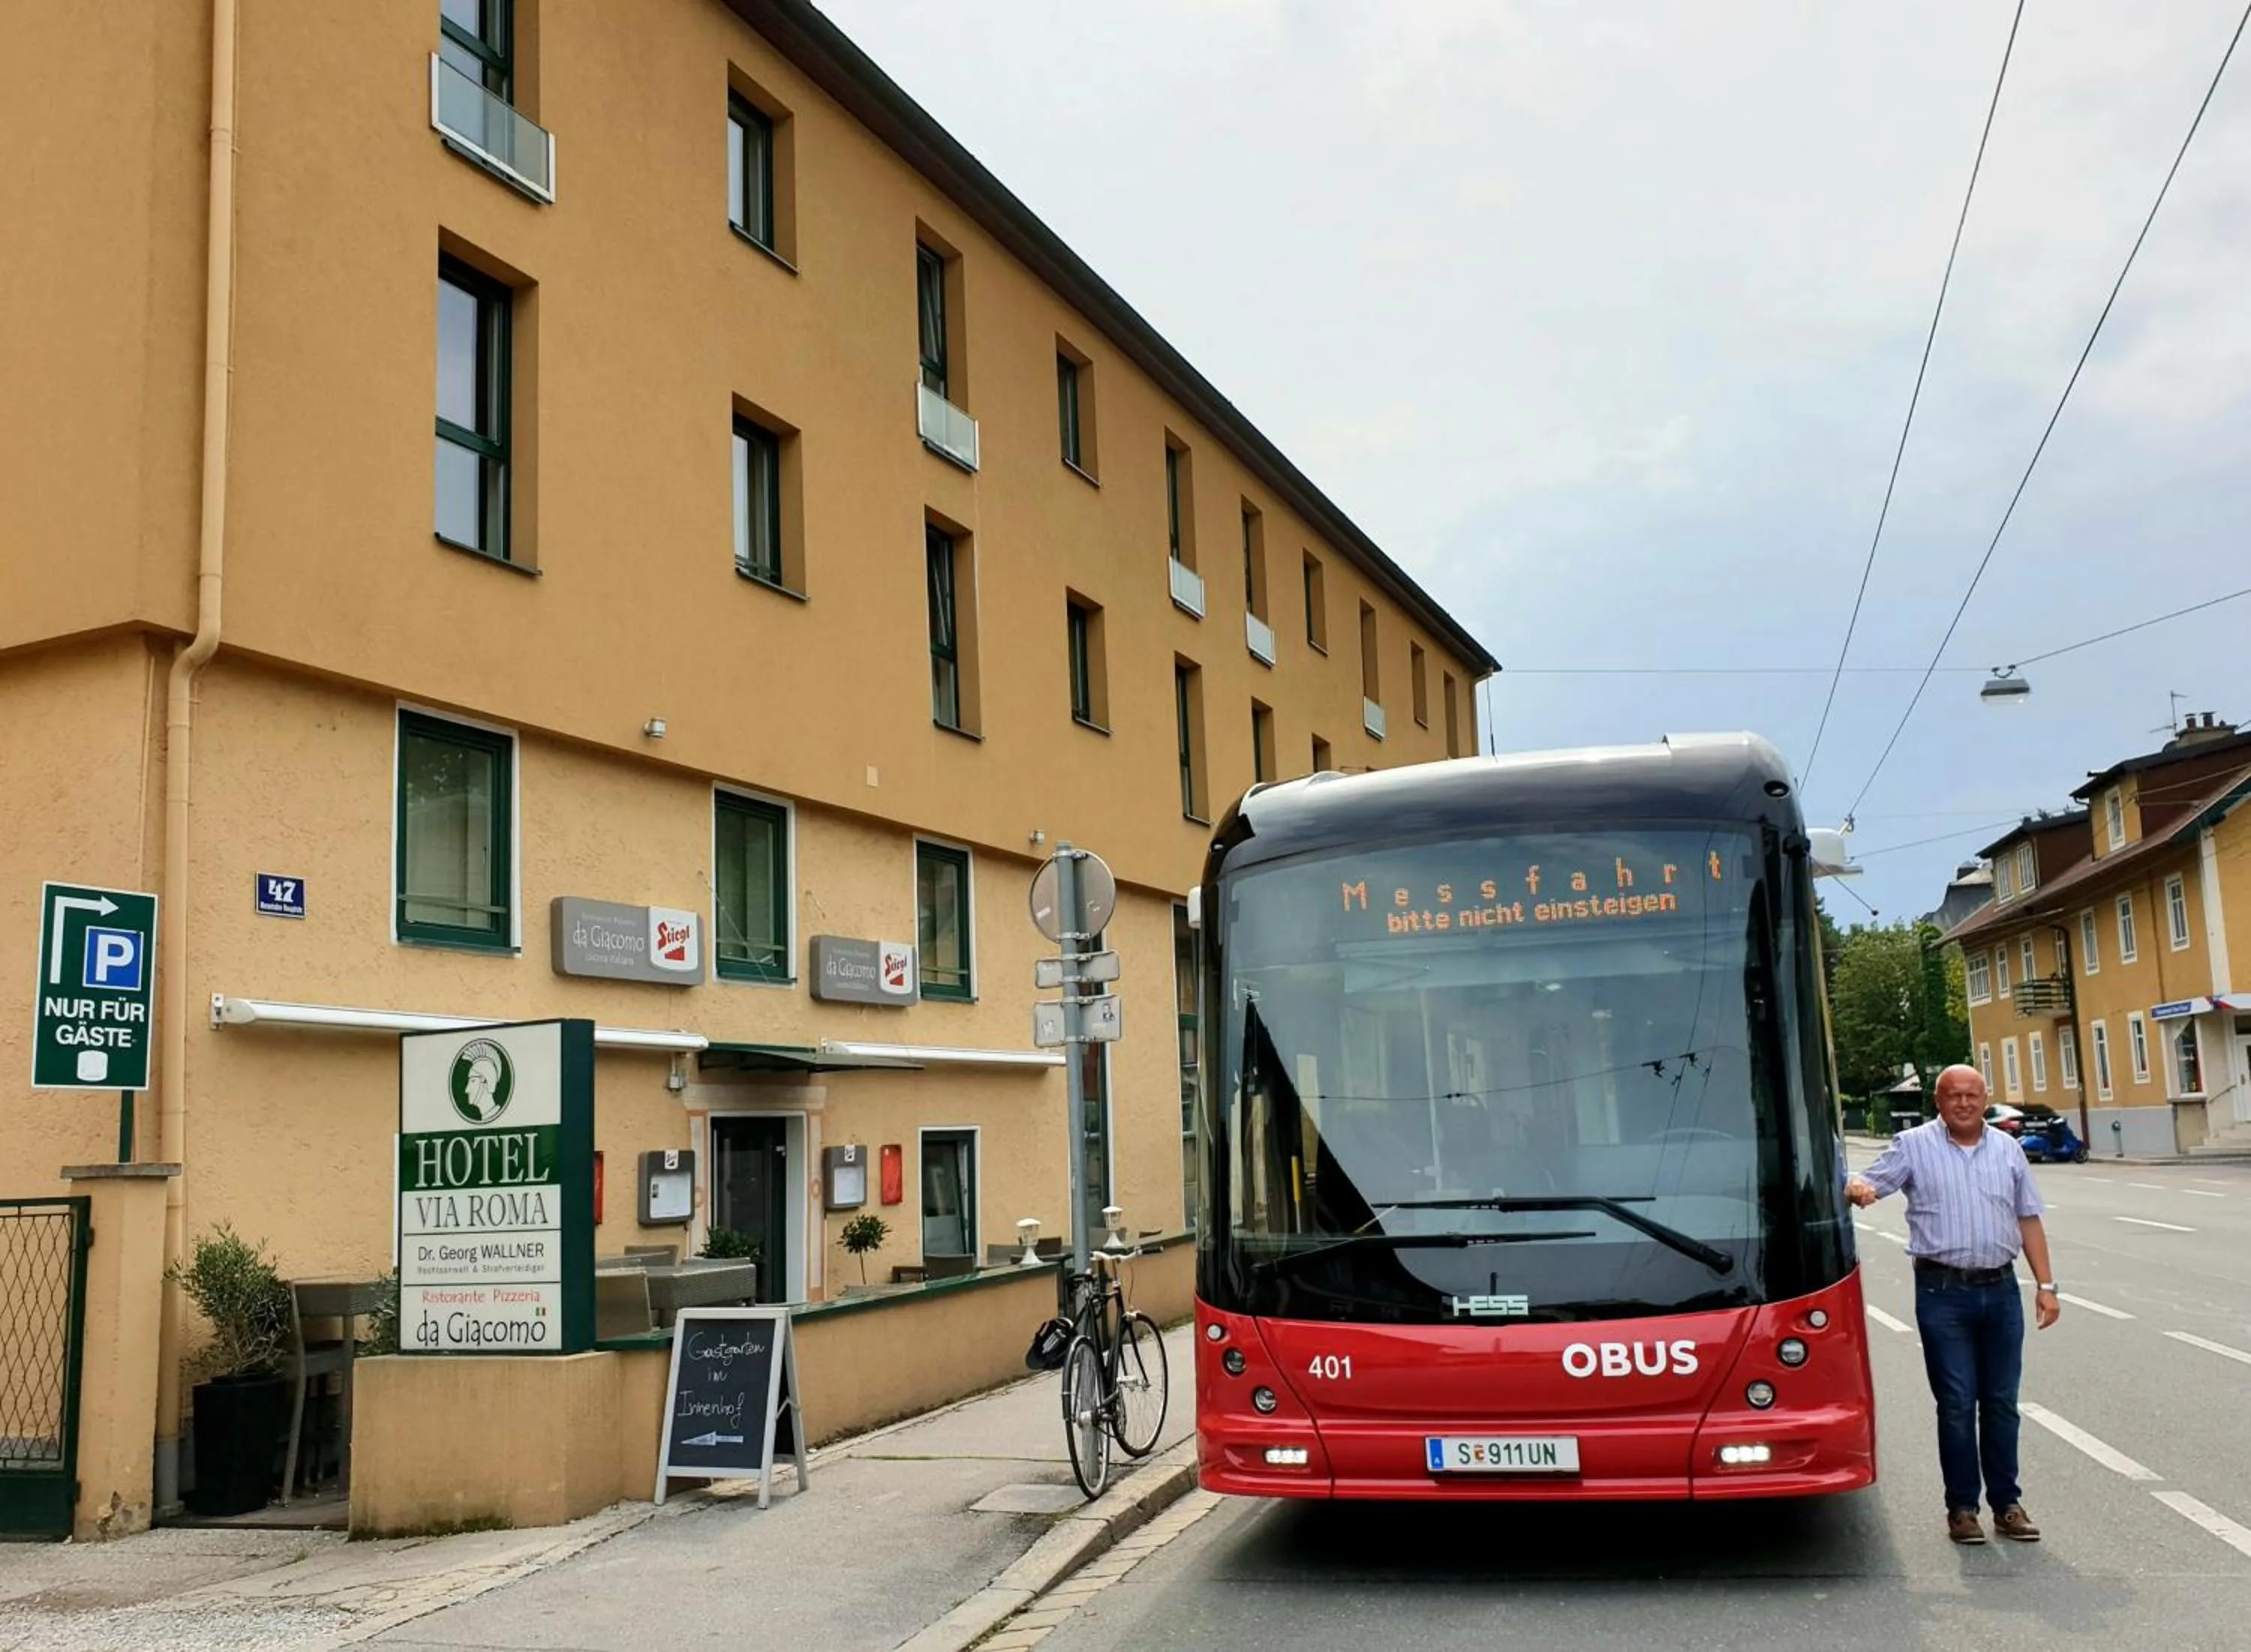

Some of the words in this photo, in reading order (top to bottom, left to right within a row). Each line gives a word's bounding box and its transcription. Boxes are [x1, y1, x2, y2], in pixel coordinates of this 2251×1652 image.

[268, 879, 296, 903] 47
[1387, 910, 1450, 934] bitte
[1459, 900, 1523, 927] nicht
[1534, 892, 1676, 922] einsteigen
[657, 921, 690, 951] Stiegl
[95, 934, 134, 981] P
[45, 997, 95, 1020] NUR
[101, 996, 145, 1023] FÜR
[55, 1021, 132, 1048] GÄSTE
[415, 1132, 549, 1188] HOTEL
[416, 1196, 460, 1228] VIA
[468, 1191, 548, 1227] ROMA
[418, 1246, 435, 1261] Dr.
[439, 1245, 477, 1263] Georg
[480, 1242, 544, 1259] WALLNER
[422, 1290, 485, 1303] Ristorante
[493, 1288, 540, 1302] Pizzeria
[1453, 1294, 1528, 1316] HESS
[416, 1309, 439, 1347] da
[447, 1311, 546, 1347] Giacomo
[687, 1332, 765, 1366] Gastgarten
[1562, 1340, 1699, 1377] OBUS
[1309, 1355, 1351, 1380] 401
[678, 1390, 744, 1428] Innenhof
[1458, 1443, 1471, 1464] S
[1488, 1443, 1557, 1465] 911UN
